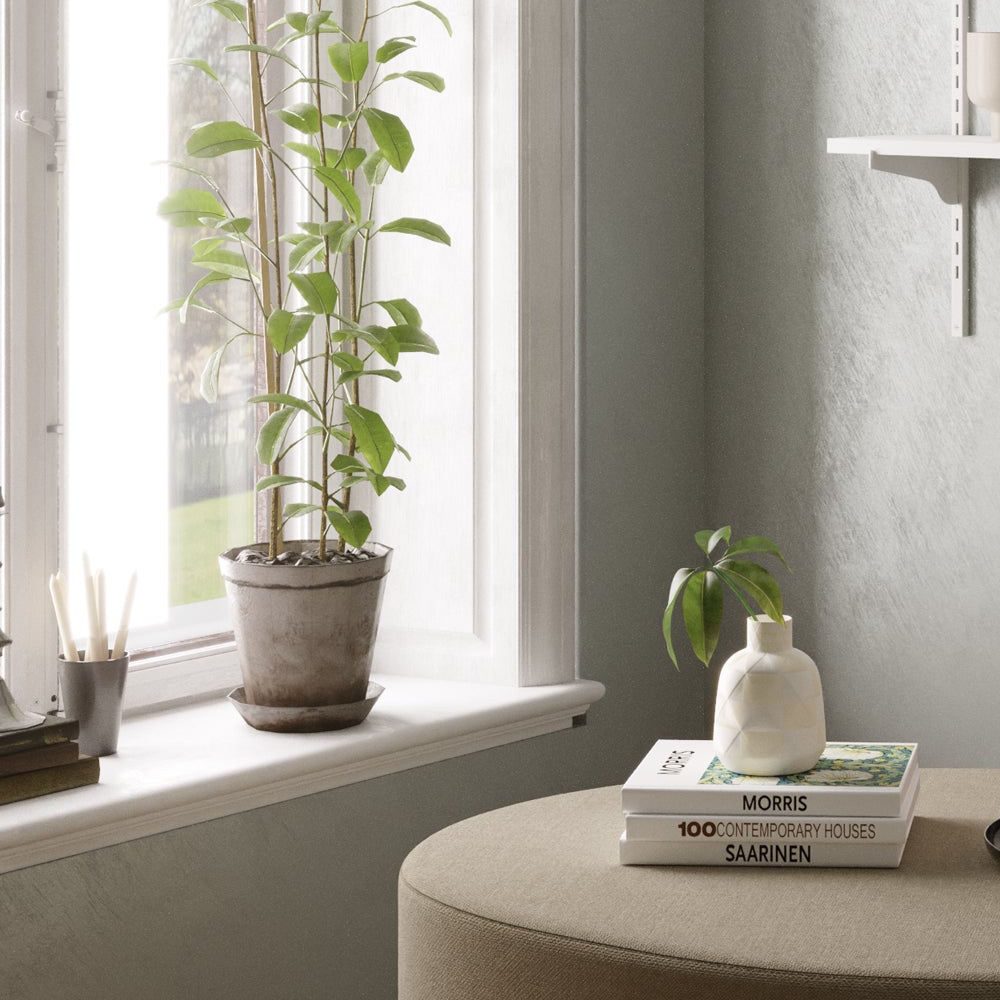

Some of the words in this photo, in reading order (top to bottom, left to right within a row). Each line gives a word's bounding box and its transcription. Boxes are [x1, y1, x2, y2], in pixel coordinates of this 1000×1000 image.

[657, 750, 695, 775] MORRIS
[742, 795, 808, 812] MORRIS
[824, 823, 876, 839] HOUSES
[725, 844, 811, 864] SAARINEN
